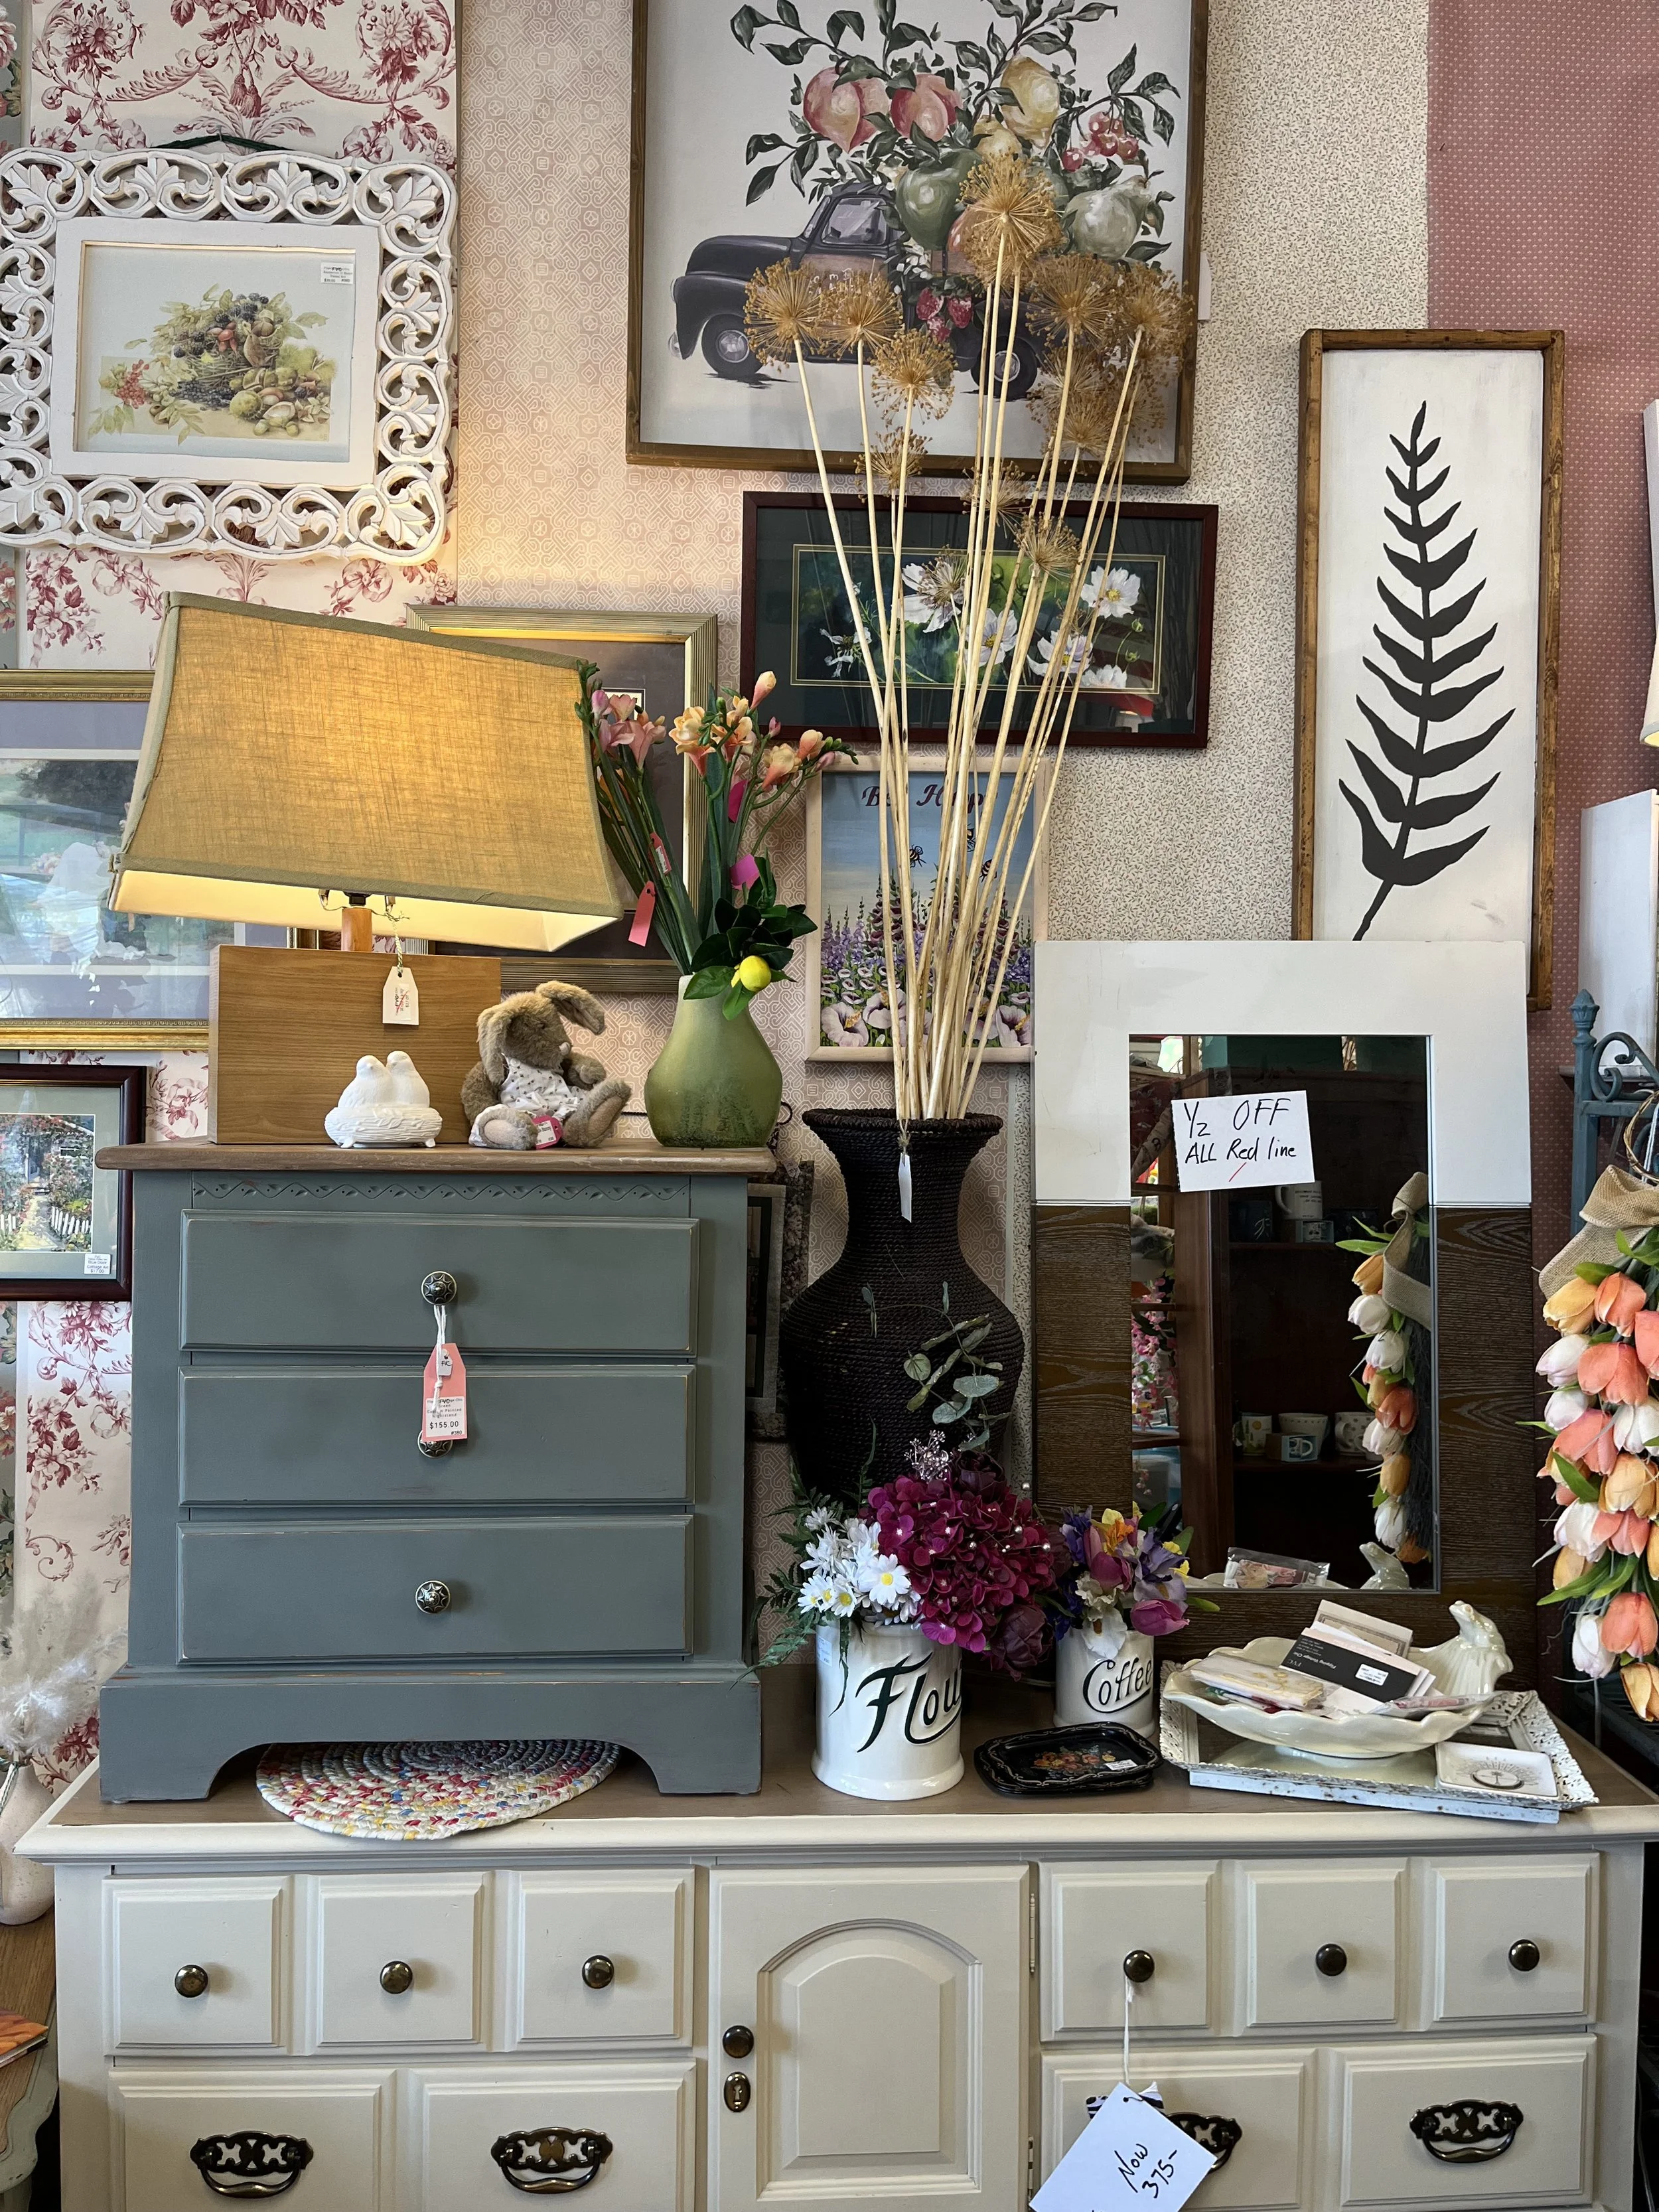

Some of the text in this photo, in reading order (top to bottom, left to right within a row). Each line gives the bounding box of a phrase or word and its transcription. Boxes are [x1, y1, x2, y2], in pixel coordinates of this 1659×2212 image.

[1233, 1098, 1291, 1131] OFF
[1185, 1136, 1297, 1164] ALL Red line
[429, 1420, 459, 1430] $155.00
[855, 1651, 962, 1753] Flou
[1082, 1657, 1153, 1714] Coffee
[1114, 2143, 1149, 2193] Now
